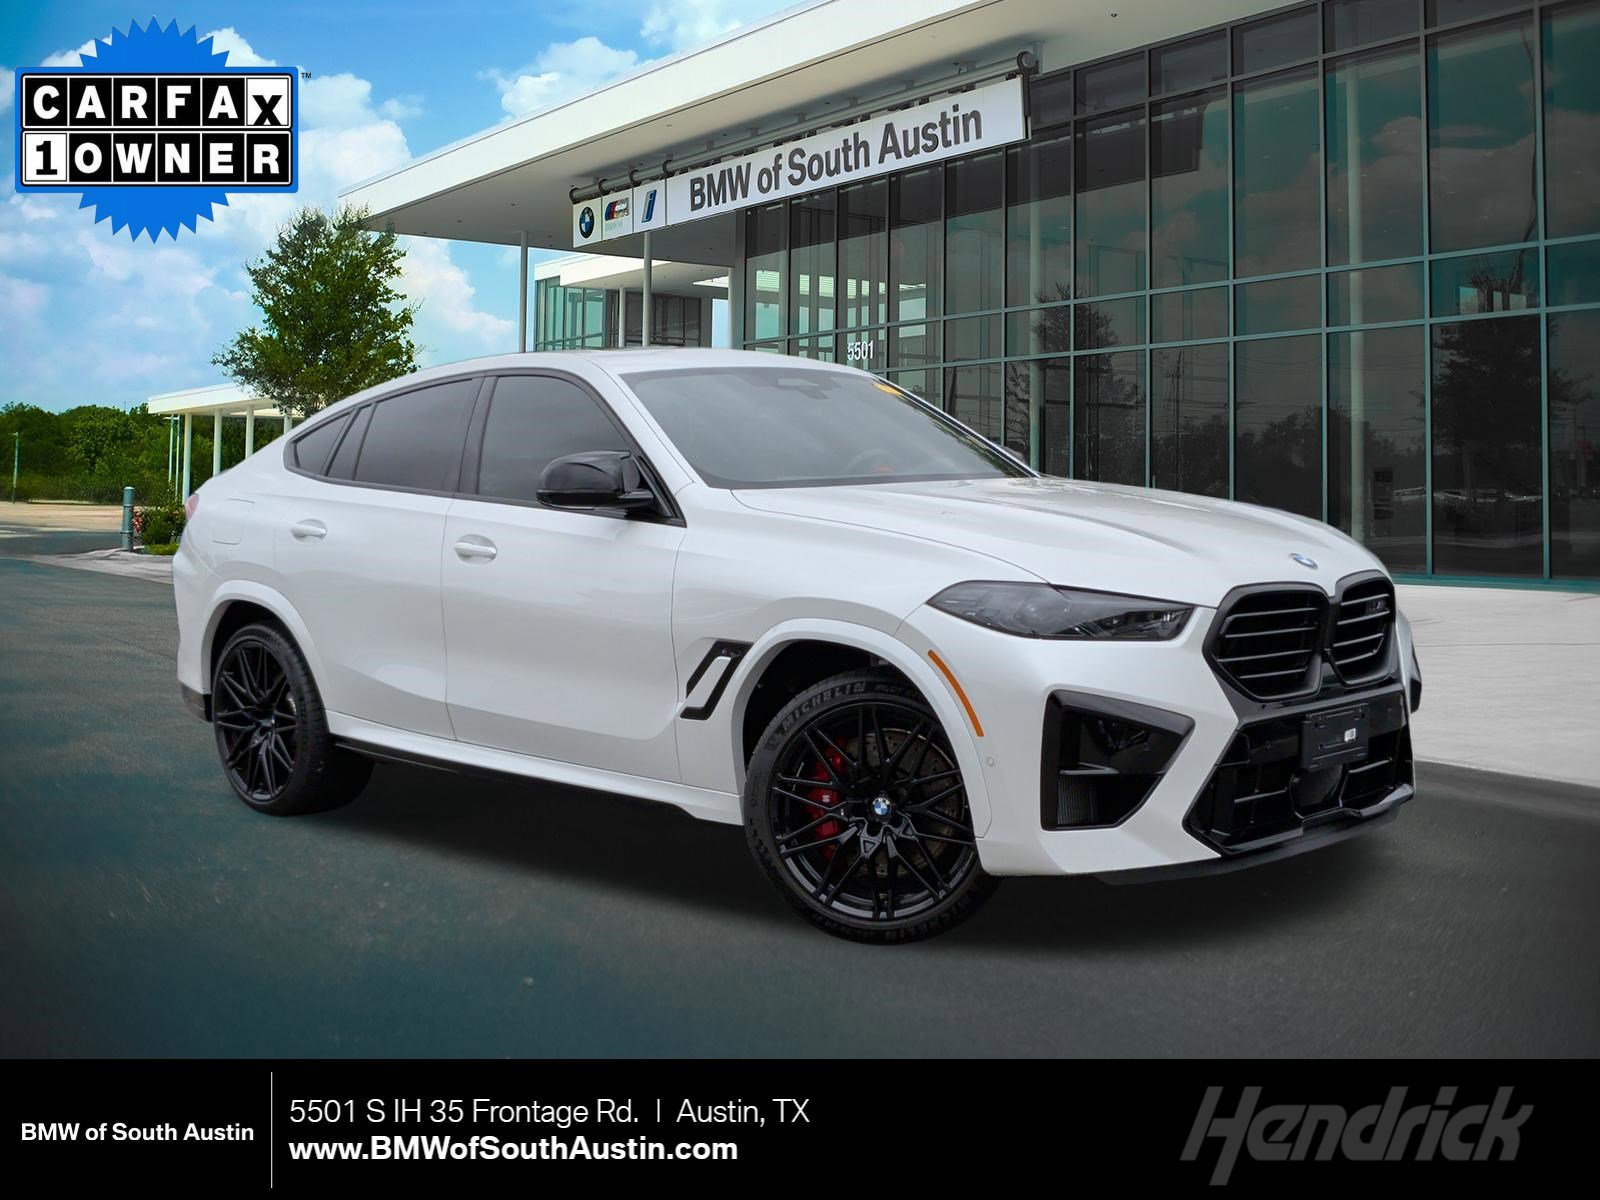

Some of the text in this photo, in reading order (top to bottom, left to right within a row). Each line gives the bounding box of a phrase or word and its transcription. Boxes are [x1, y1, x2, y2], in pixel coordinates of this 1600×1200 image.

[690, 162, 752, 211] BMW
[757, 153, 783, 194] of
[787, 132, 870, 186] South
[878, 104, 982, 164] Austin
[847, 339, 874, 361] 5501
[782, 682, 866, 732] MICHELIN
